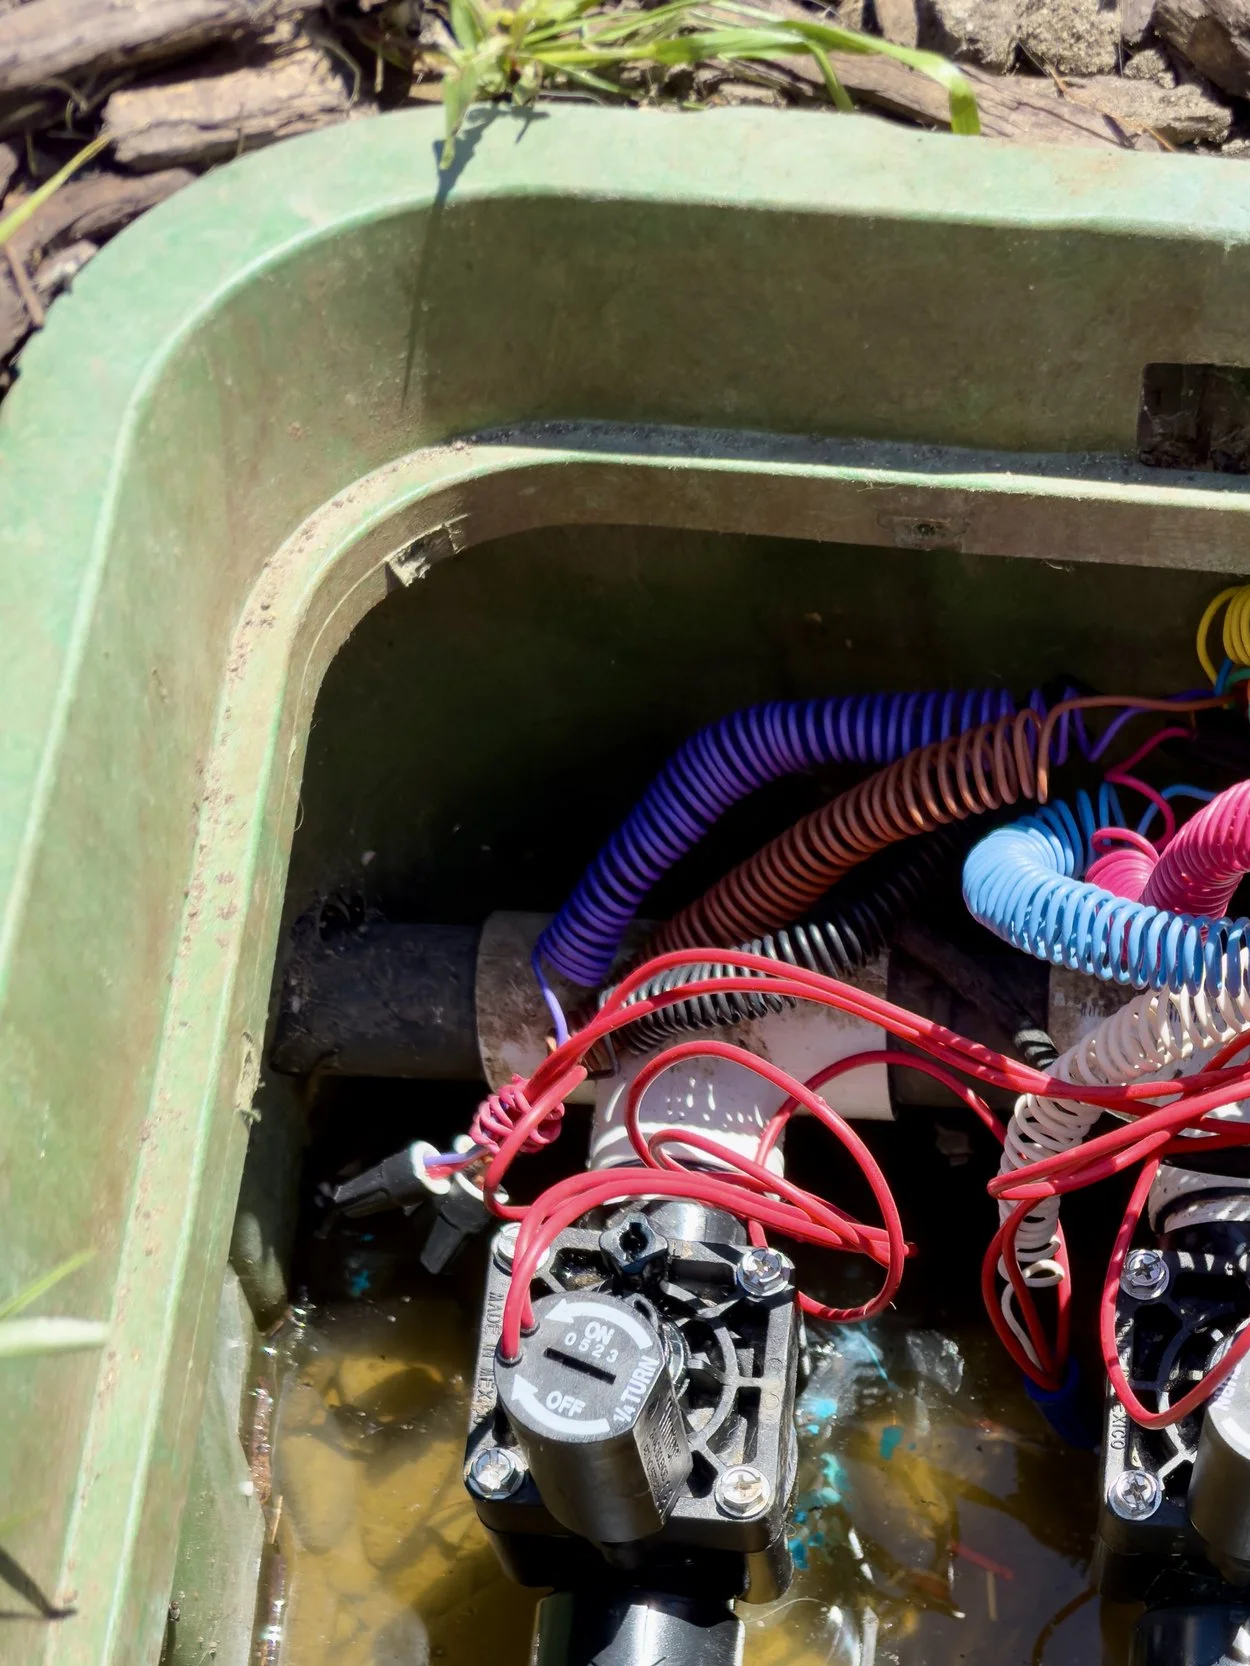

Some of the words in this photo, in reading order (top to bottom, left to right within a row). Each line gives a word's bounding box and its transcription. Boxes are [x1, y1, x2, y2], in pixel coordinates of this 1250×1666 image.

[564, 1332, 620, 1364] 0523
[584, 1320, 615, 1346] ON
[474, 1366, 494, 1426] MEXO
[545, 1390, 586, 1417] OFF
[612, 1396, 634, 1424] 1/4
[627, 1355, 660, 1405] TURN
